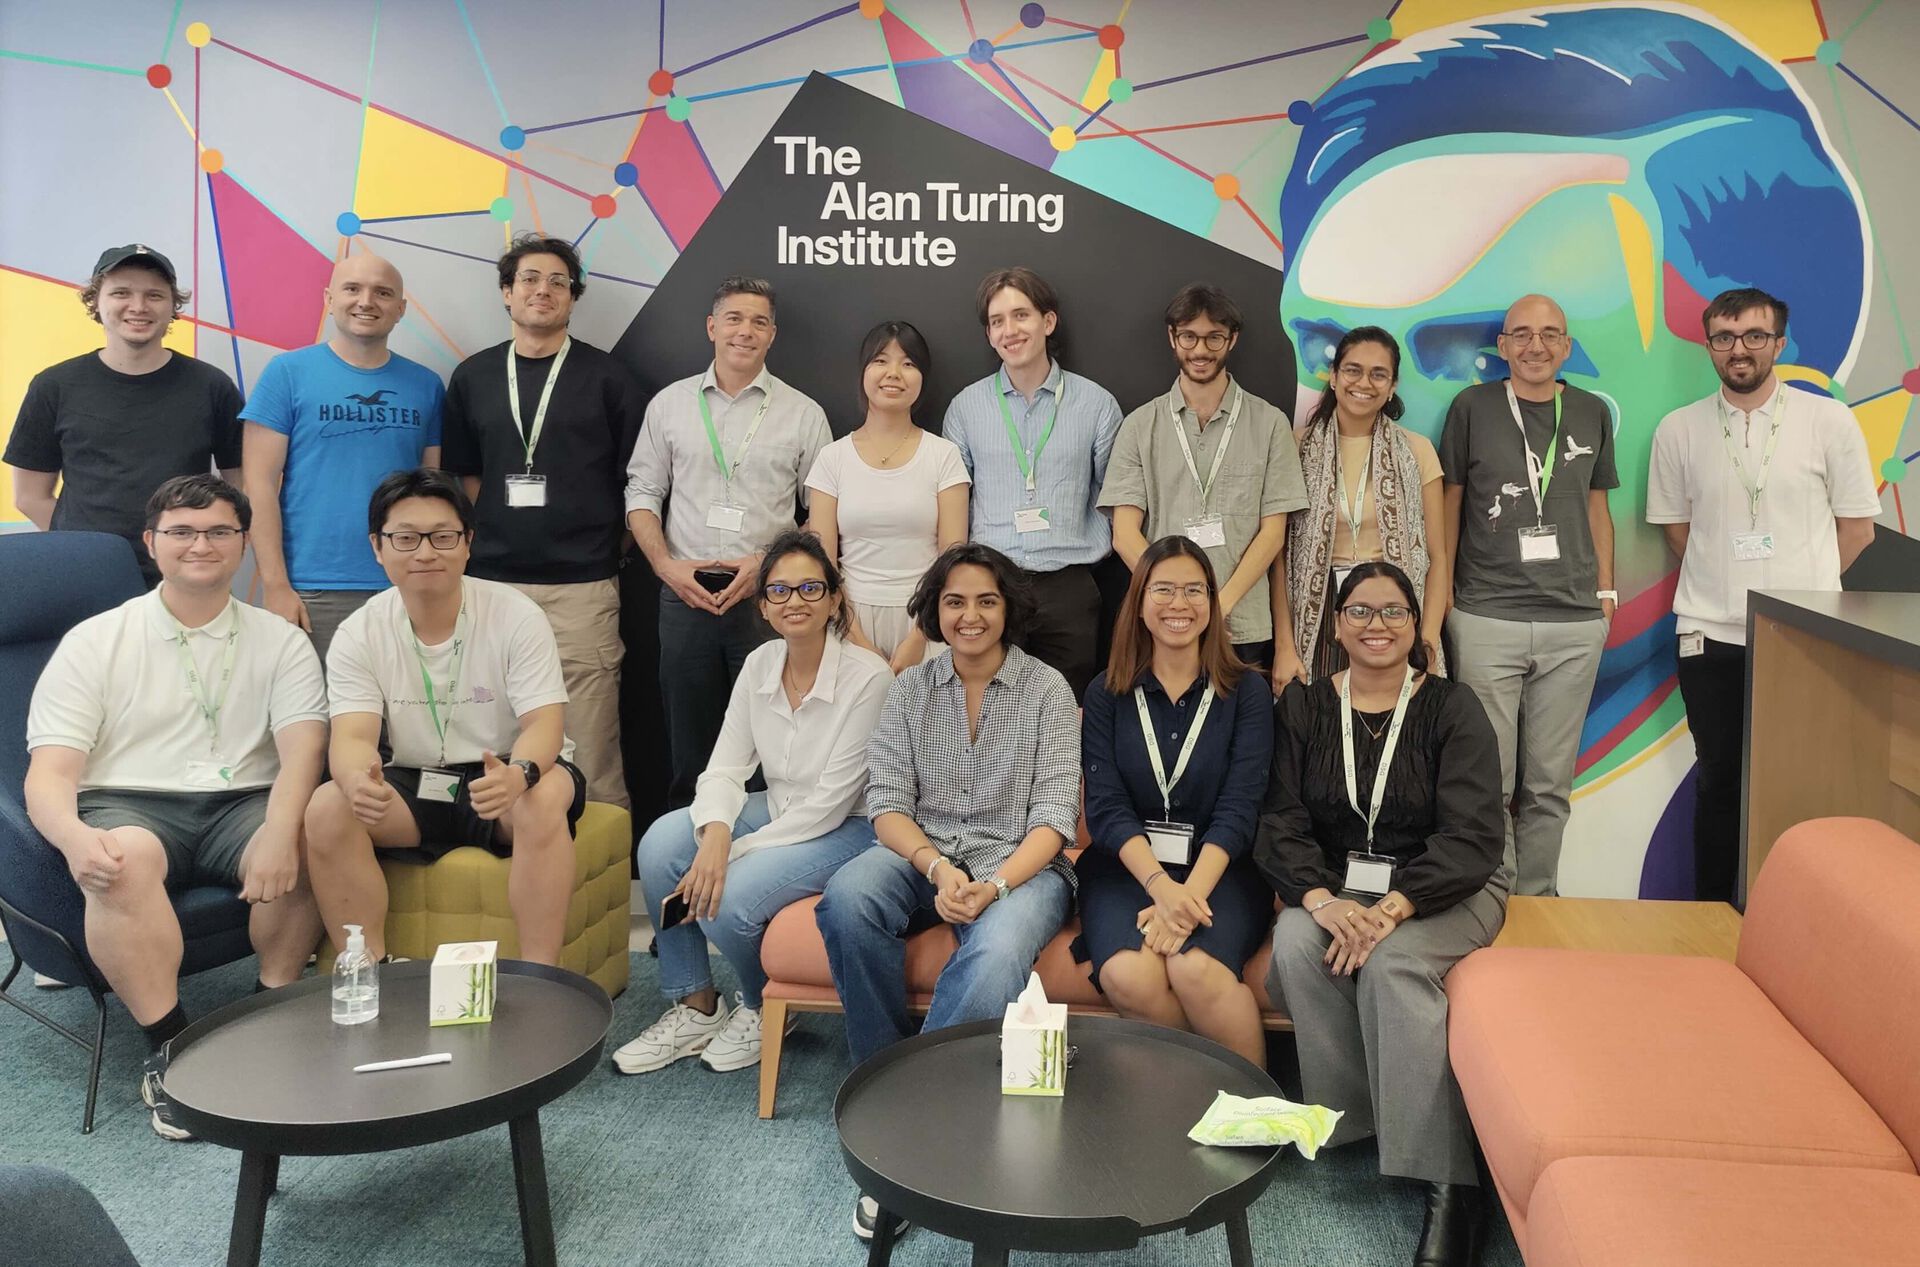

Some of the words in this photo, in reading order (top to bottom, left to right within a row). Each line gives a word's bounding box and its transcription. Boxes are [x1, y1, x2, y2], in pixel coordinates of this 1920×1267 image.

[773, 135, 862, 176] The
[820, 181, 921, 221] Alan
[926, 182, 1064, 233] Turing
[777, 225, 957, 267] Institute
[319, 404, 421, 427] HOLLISTER
